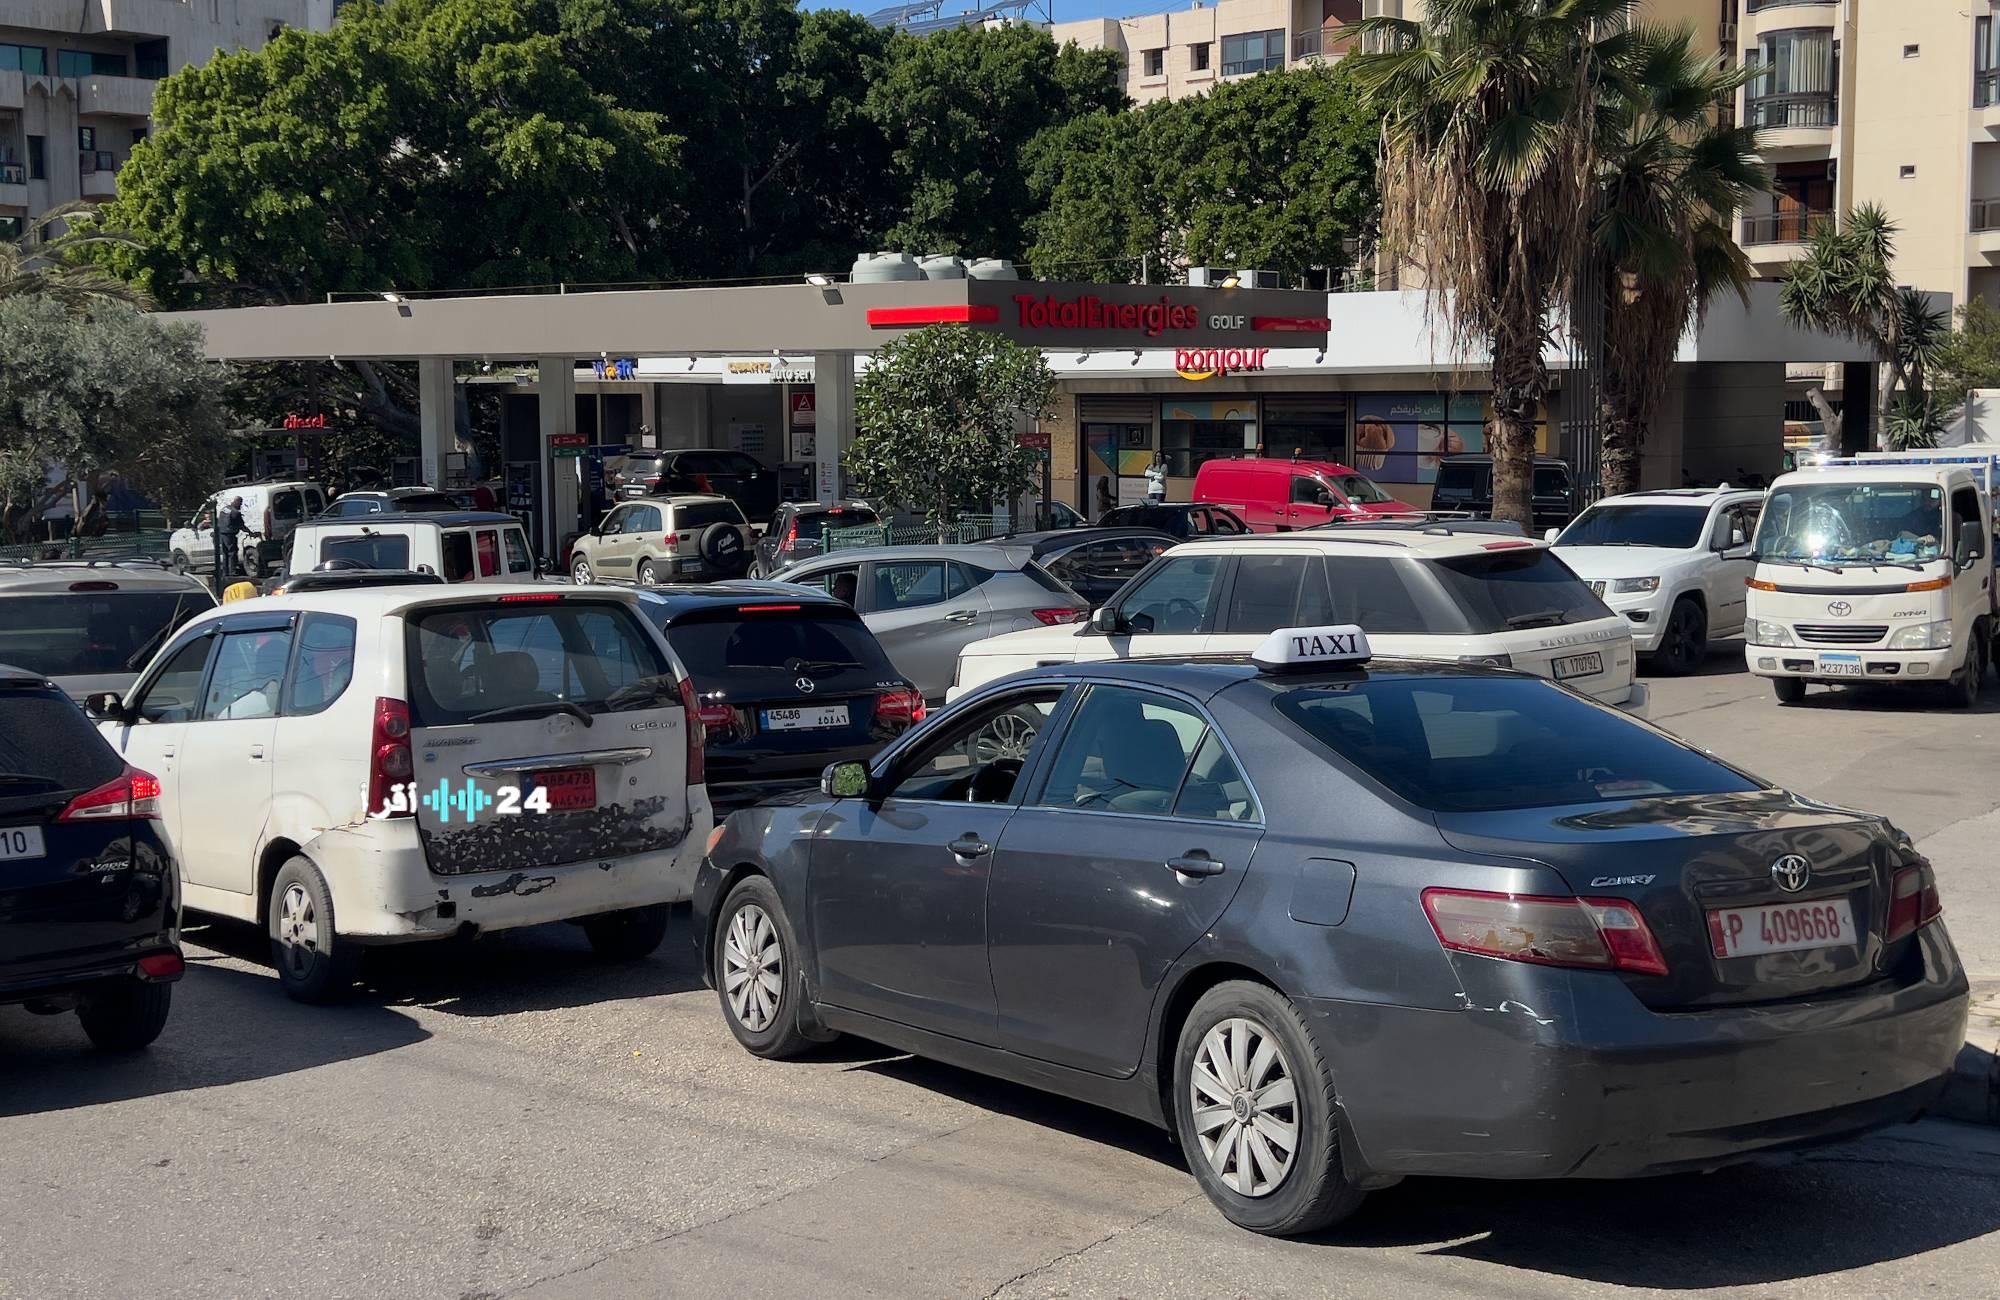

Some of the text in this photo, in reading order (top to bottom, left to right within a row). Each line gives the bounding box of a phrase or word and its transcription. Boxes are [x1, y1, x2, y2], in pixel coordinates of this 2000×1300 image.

[1014, 294, 1245, 337] TotalEnergies GOLF
[1175, 348, 1269, 377] bonjour
[283, 414, 324, 428] diesel
[1892, 610, 1927, 618] DYNA
[1292, 633, 1359, 657] TAXI
[1569, 655, 1598, 673] 170792
[1820, 661, 1860, 674] M237136
[769, 709, 801, 721] 45486
[818, 714, 847, 725] ٤٥٤٨٦
[90, 860, 129, 873] YARIS
[1727, 906, 1841, 949] P 409668
